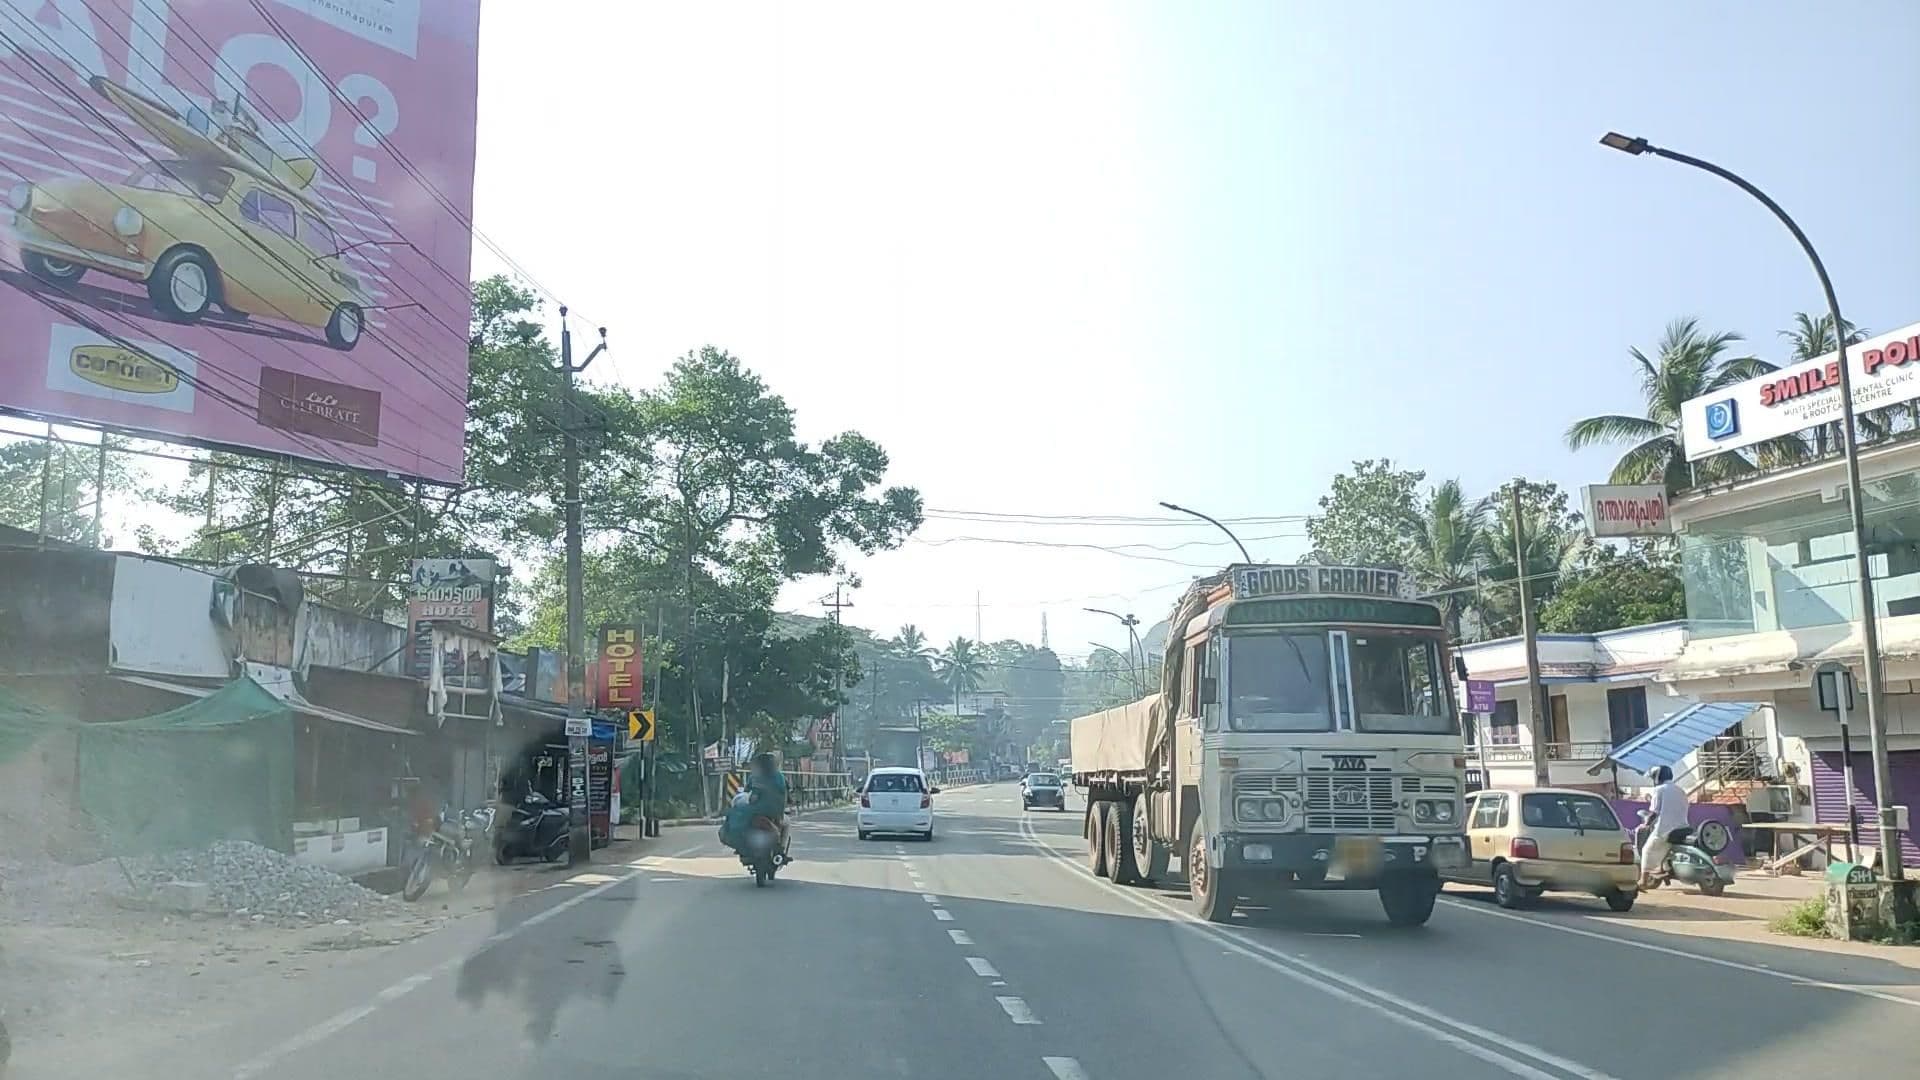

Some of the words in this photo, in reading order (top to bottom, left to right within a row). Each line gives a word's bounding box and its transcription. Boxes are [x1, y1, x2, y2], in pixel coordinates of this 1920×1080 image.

[1760, 361, 1841, 407] SMILE
[1807, 393, 1842, 412] SPECIALI
[1852, 382, 1884, 397] DENTAL
[1885, 372, 1914, 388] CLINIC
[1809, 406, 1831, 418] ROOT
[1859, 388, 1893, 404] CENTRE
[1247, 568, 1311, 595] GOODS
[1317, 567, 1400, 598] CARRIER
[422, 604, 476, 617] HOTEL
[606, 629, 635, 702] HOTEL
[1333, 757, 1367, 769] TATA
